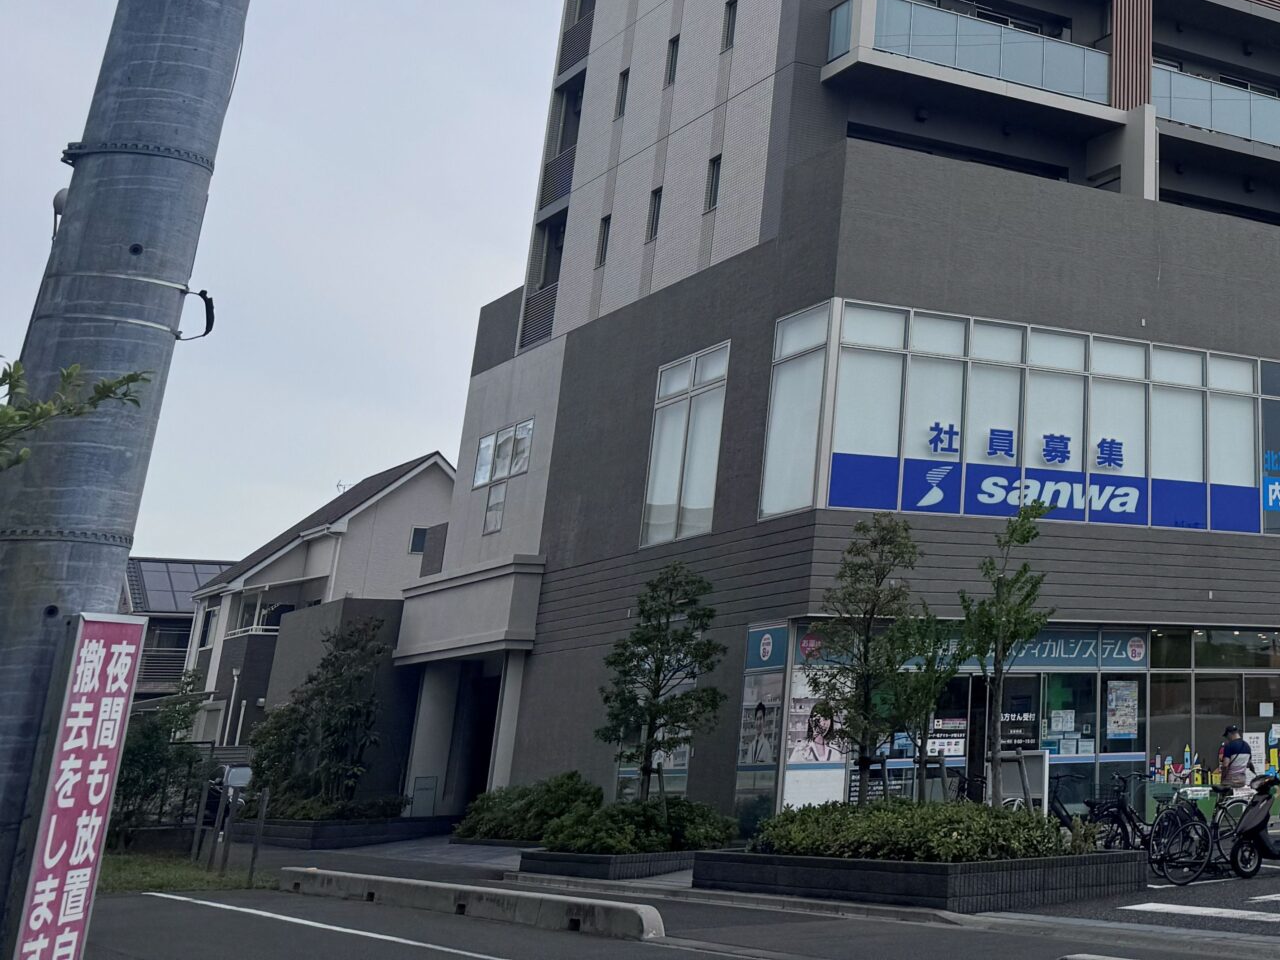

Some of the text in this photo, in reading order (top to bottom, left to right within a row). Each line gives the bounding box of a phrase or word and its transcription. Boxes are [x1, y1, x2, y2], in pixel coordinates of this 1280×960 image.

[928, 421, 1126, 470] 社員募集
[976, 476, 1140, 514] sanwa
[52, 640, 136, 960] 夜間も放置自
